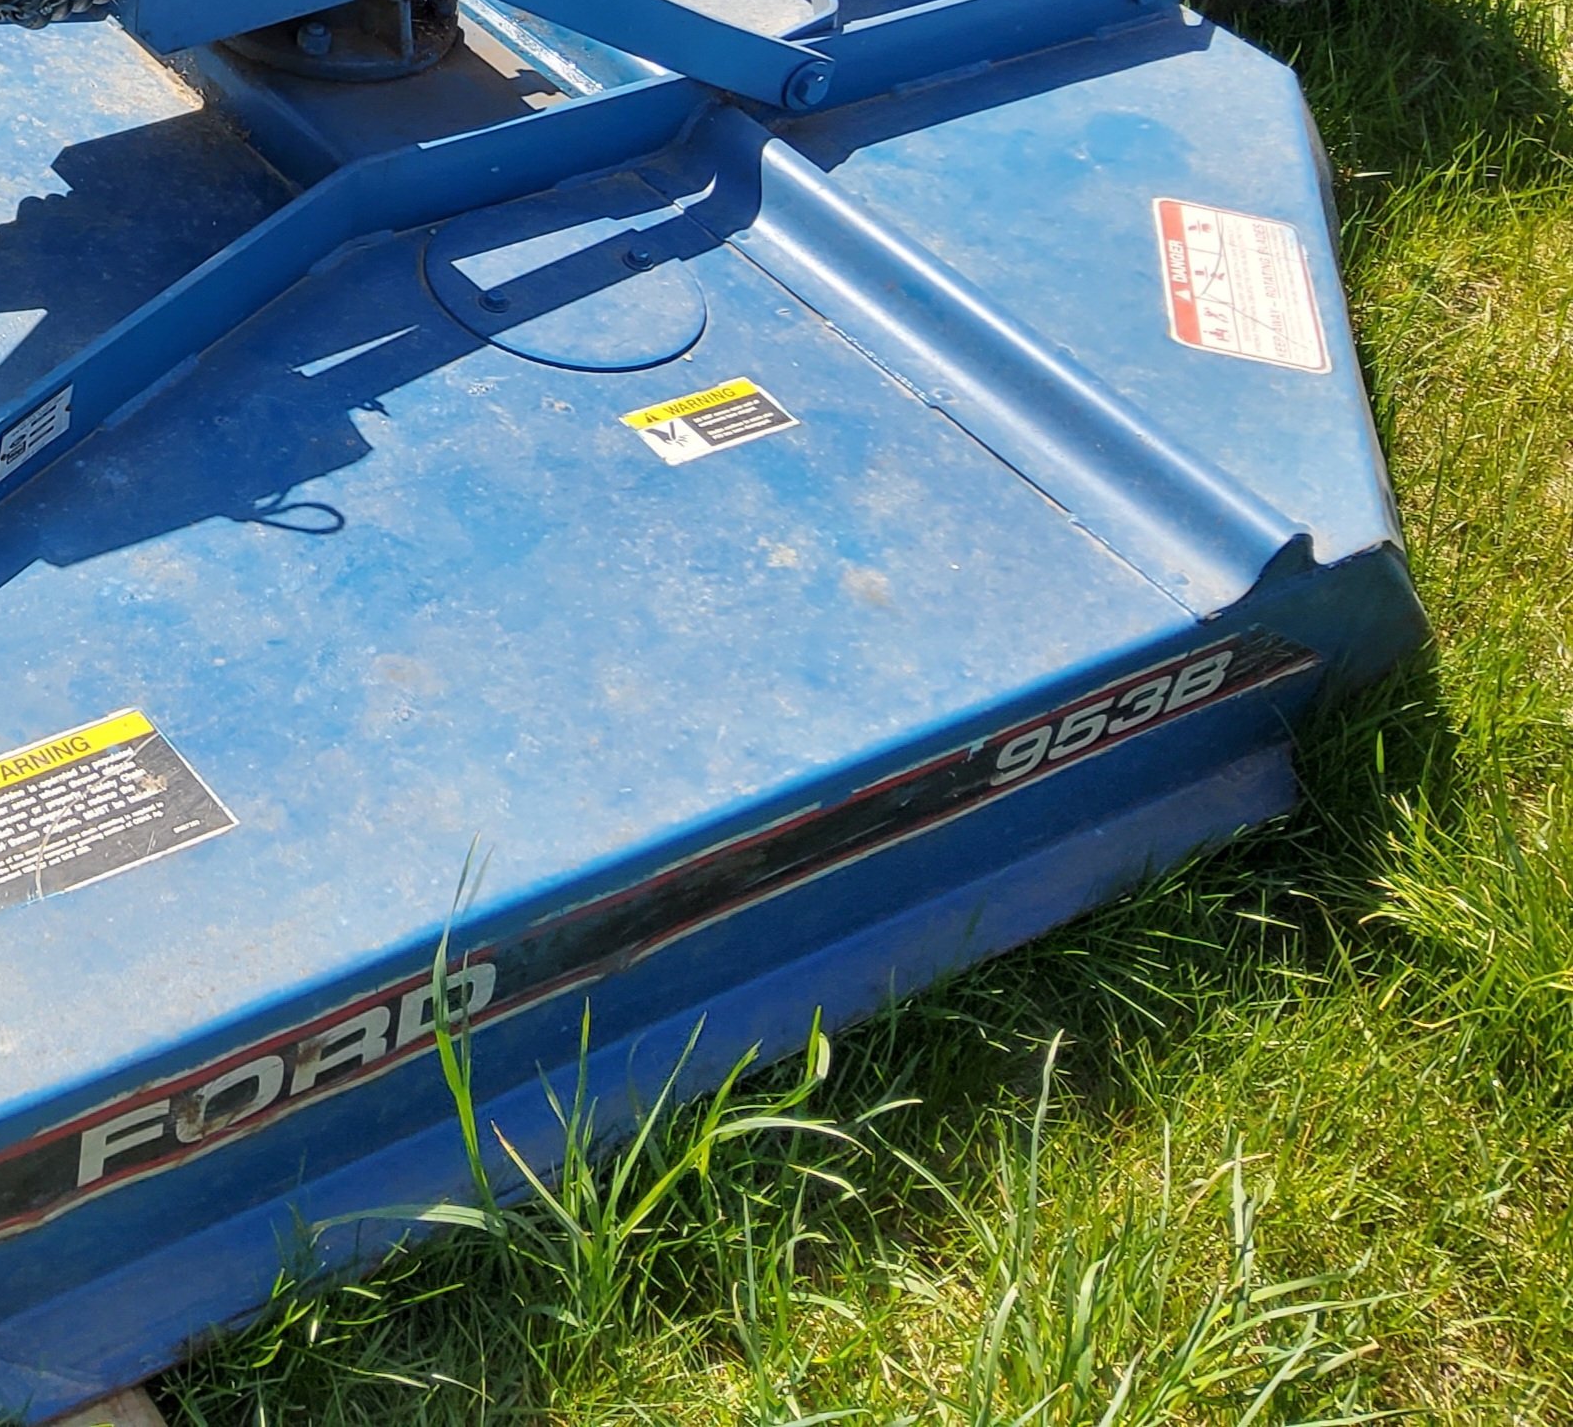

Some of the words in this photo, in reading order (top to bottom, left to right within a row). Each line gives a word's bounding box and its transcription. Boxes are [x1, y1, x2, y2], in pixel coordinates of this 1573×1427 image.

[1168, 240, 1188, 284] DANGER
[663, 388, 736, 415] WARNING
[990, 650, 1233, 786] 953B
[76, 962, 496, 1188] FORD
